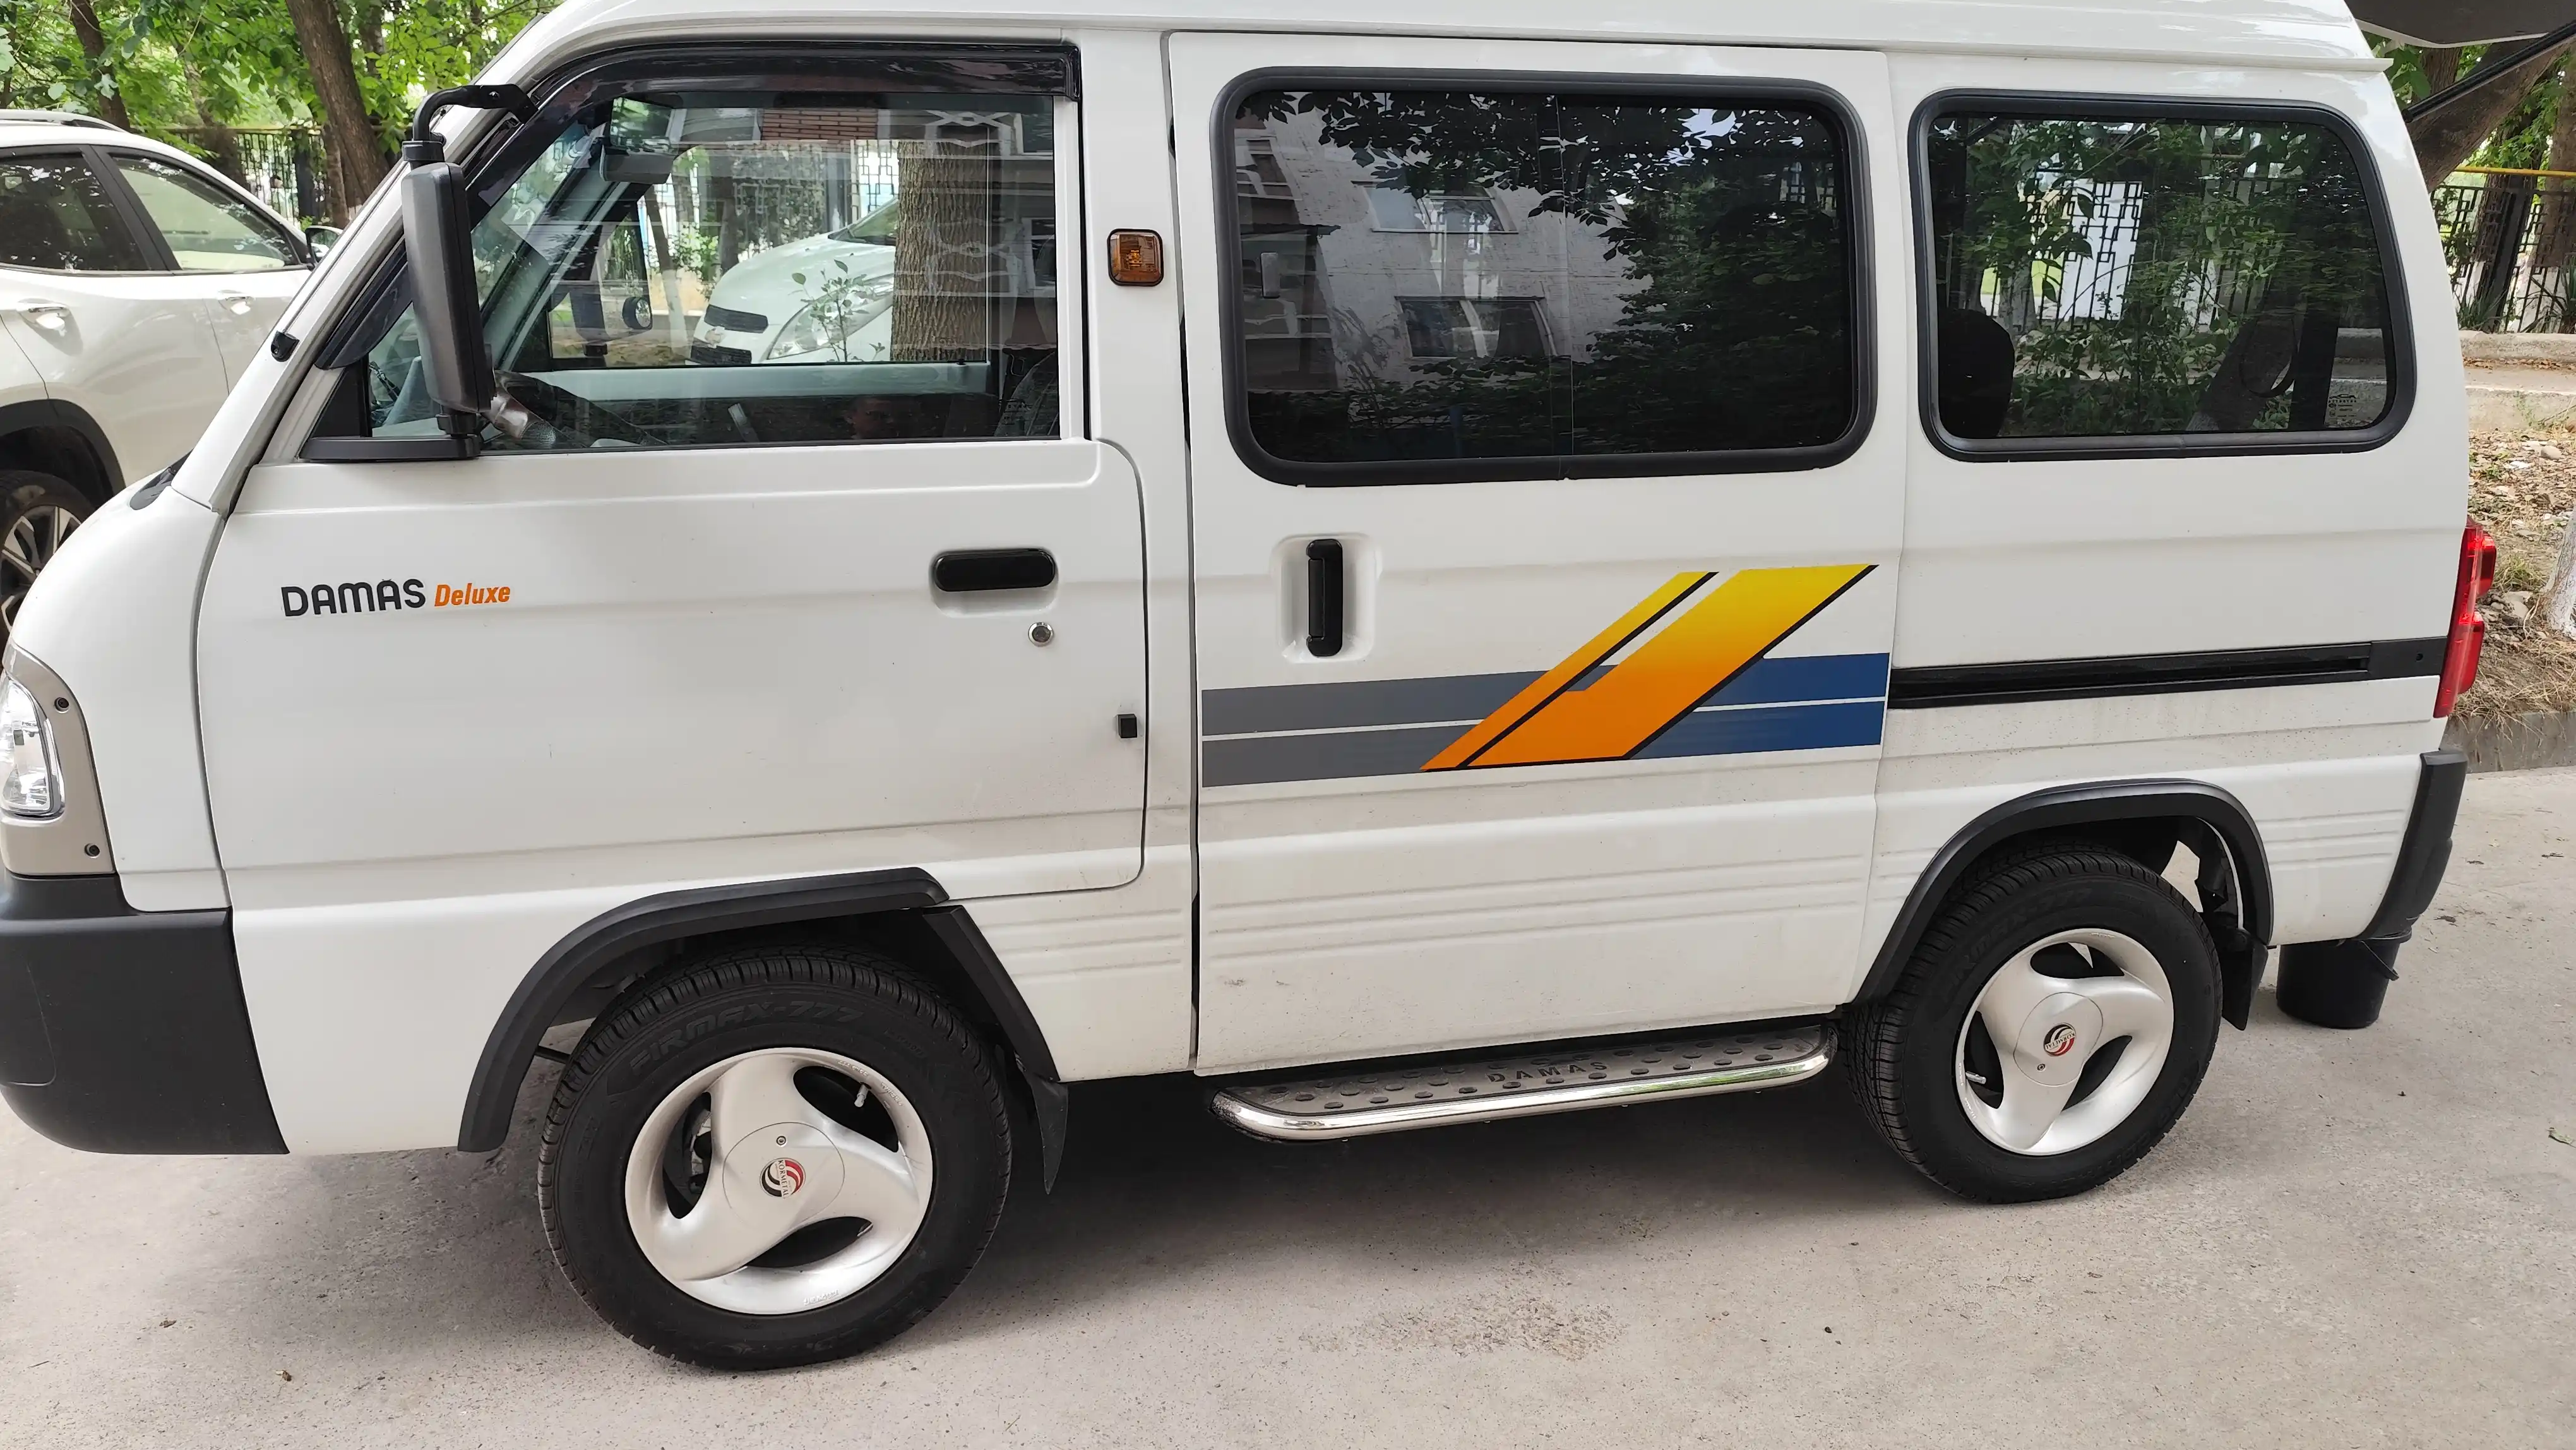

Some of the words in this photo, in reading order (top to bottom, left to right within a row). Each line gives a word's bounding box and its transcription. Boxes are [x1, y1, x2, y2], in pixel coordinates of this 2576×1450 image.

[281, 578, 426, 617] DAMAS
[434, 582, 511, 607] Deluxe
[1486, 1062, 1607, 1082] DAMAS
[778, 1159, 789, 1197] KORMETAL
